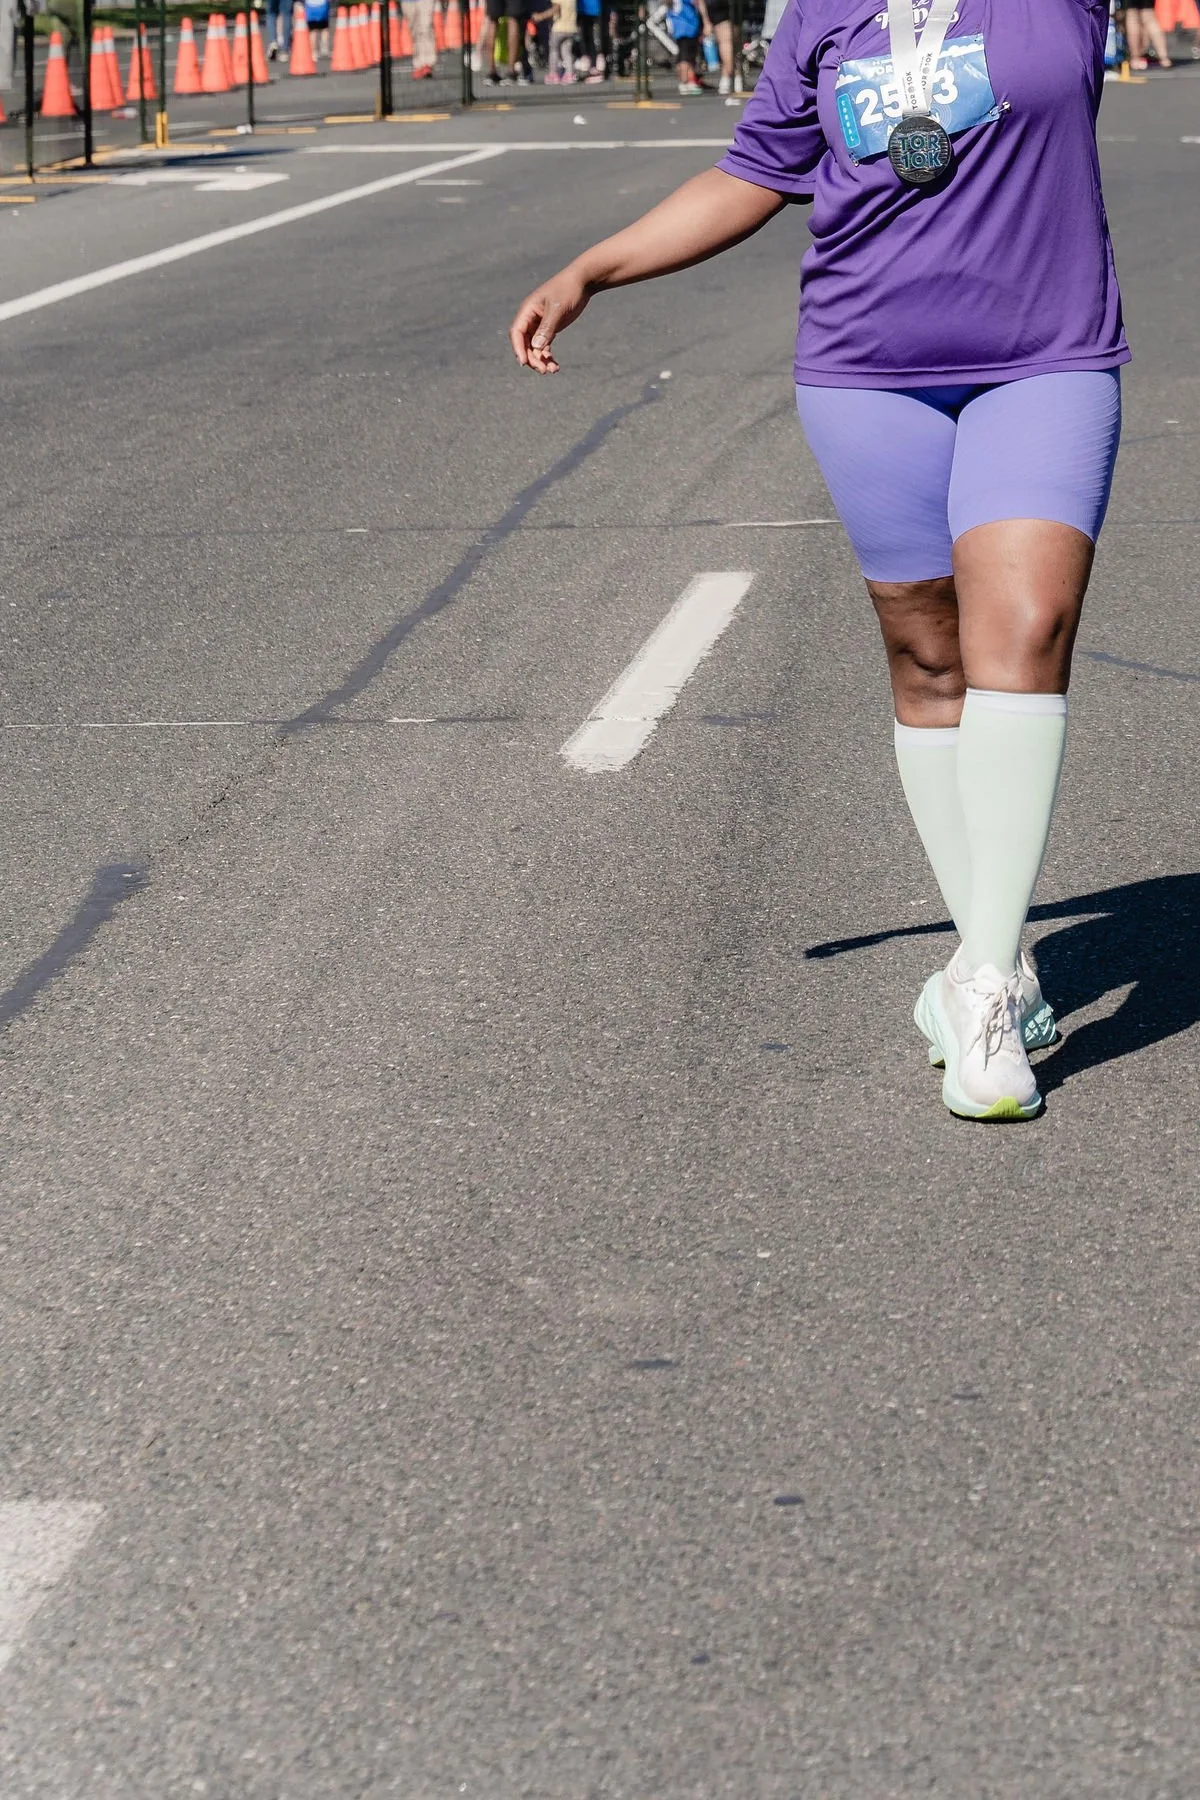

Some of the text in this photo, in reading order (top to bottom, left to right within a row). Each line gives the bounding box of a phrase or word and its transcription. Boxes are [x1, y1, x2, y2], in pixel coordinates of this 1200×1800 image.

[855, 69, 958, 126] 253
[898, 131, 940, 151] TOR
[900, 151, 942, 169] 10K
